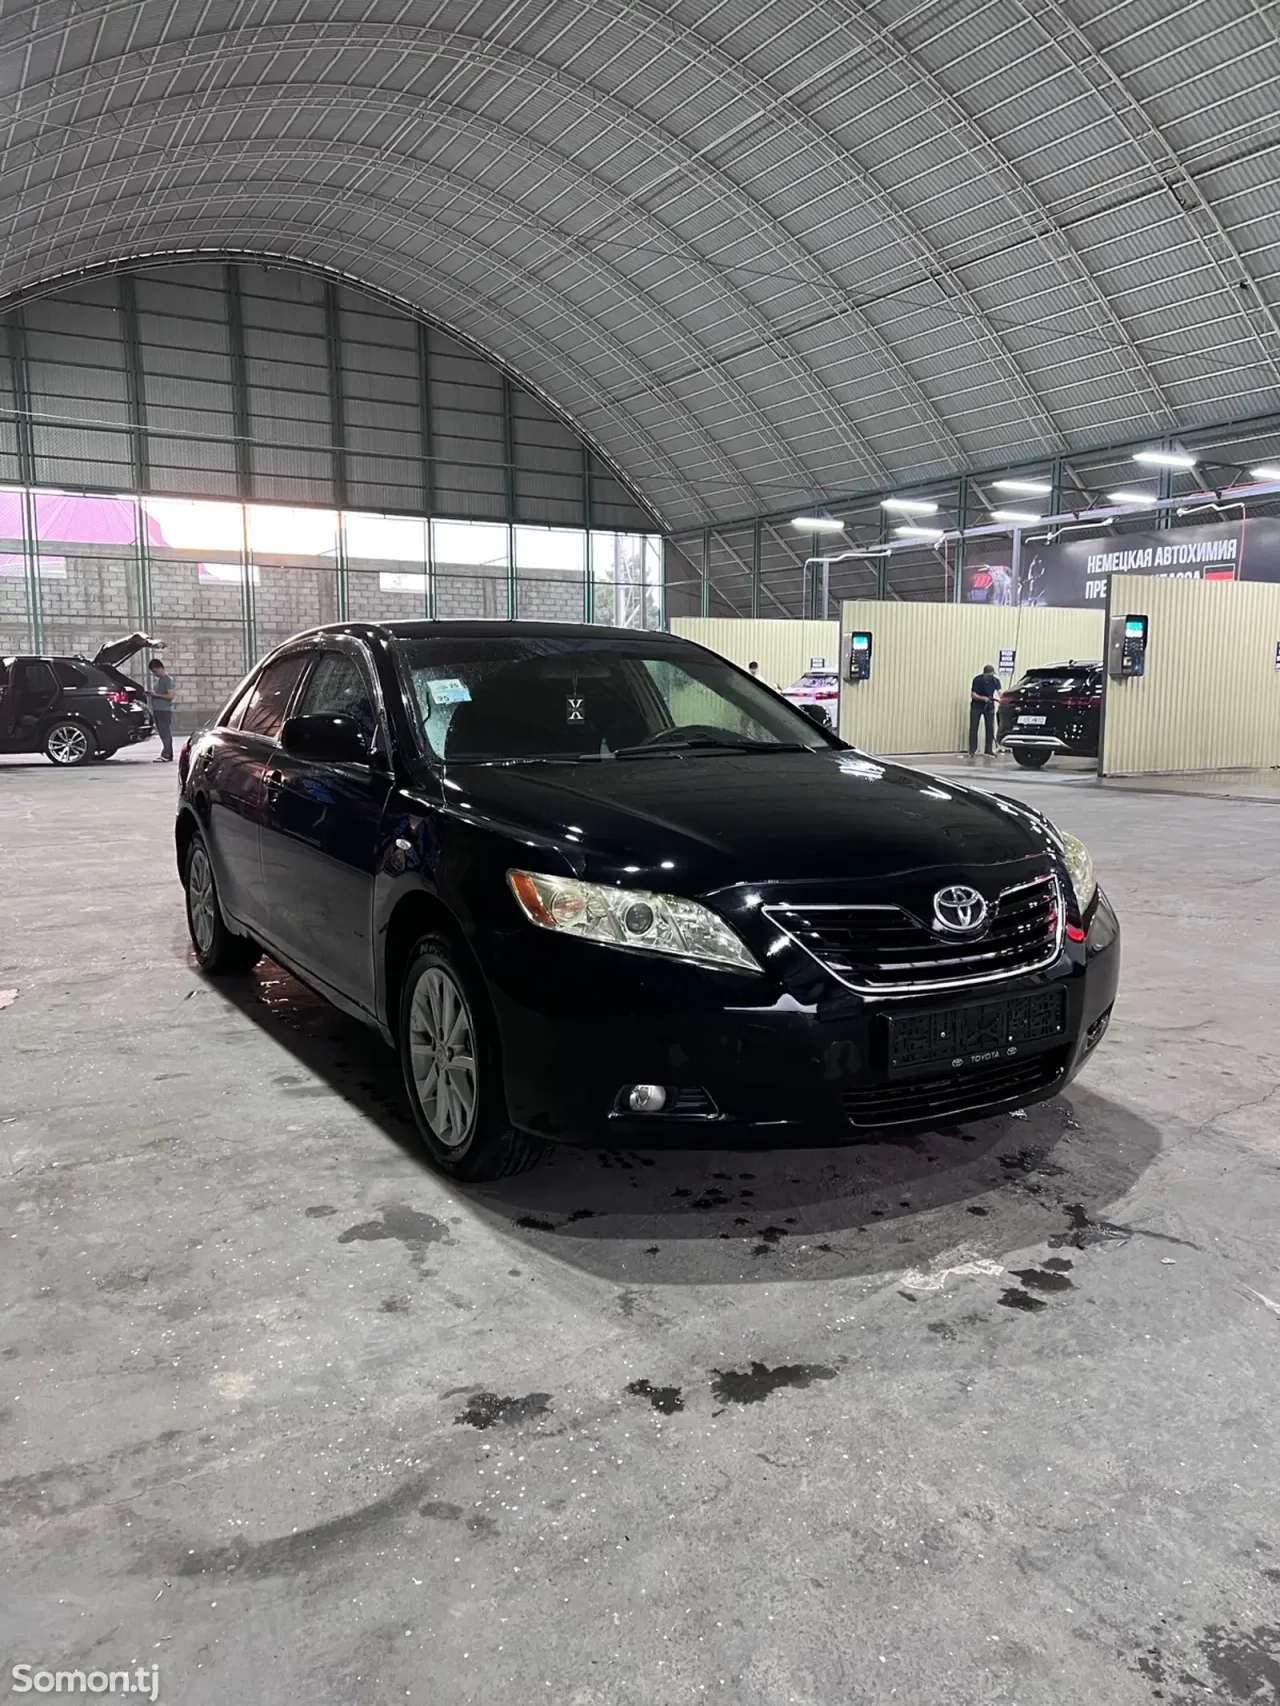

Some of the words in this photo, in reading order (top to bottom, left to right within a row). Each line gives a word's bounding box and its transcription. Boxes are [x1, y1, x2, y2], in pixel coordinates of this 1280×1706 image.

[1087, 548, 1153, 574] НЕМЕЦКАЯ
[1154, 539, 1237, 566] АВТОХИМИЯ
[970, 1051, 1000, 1063] TOYOTA
